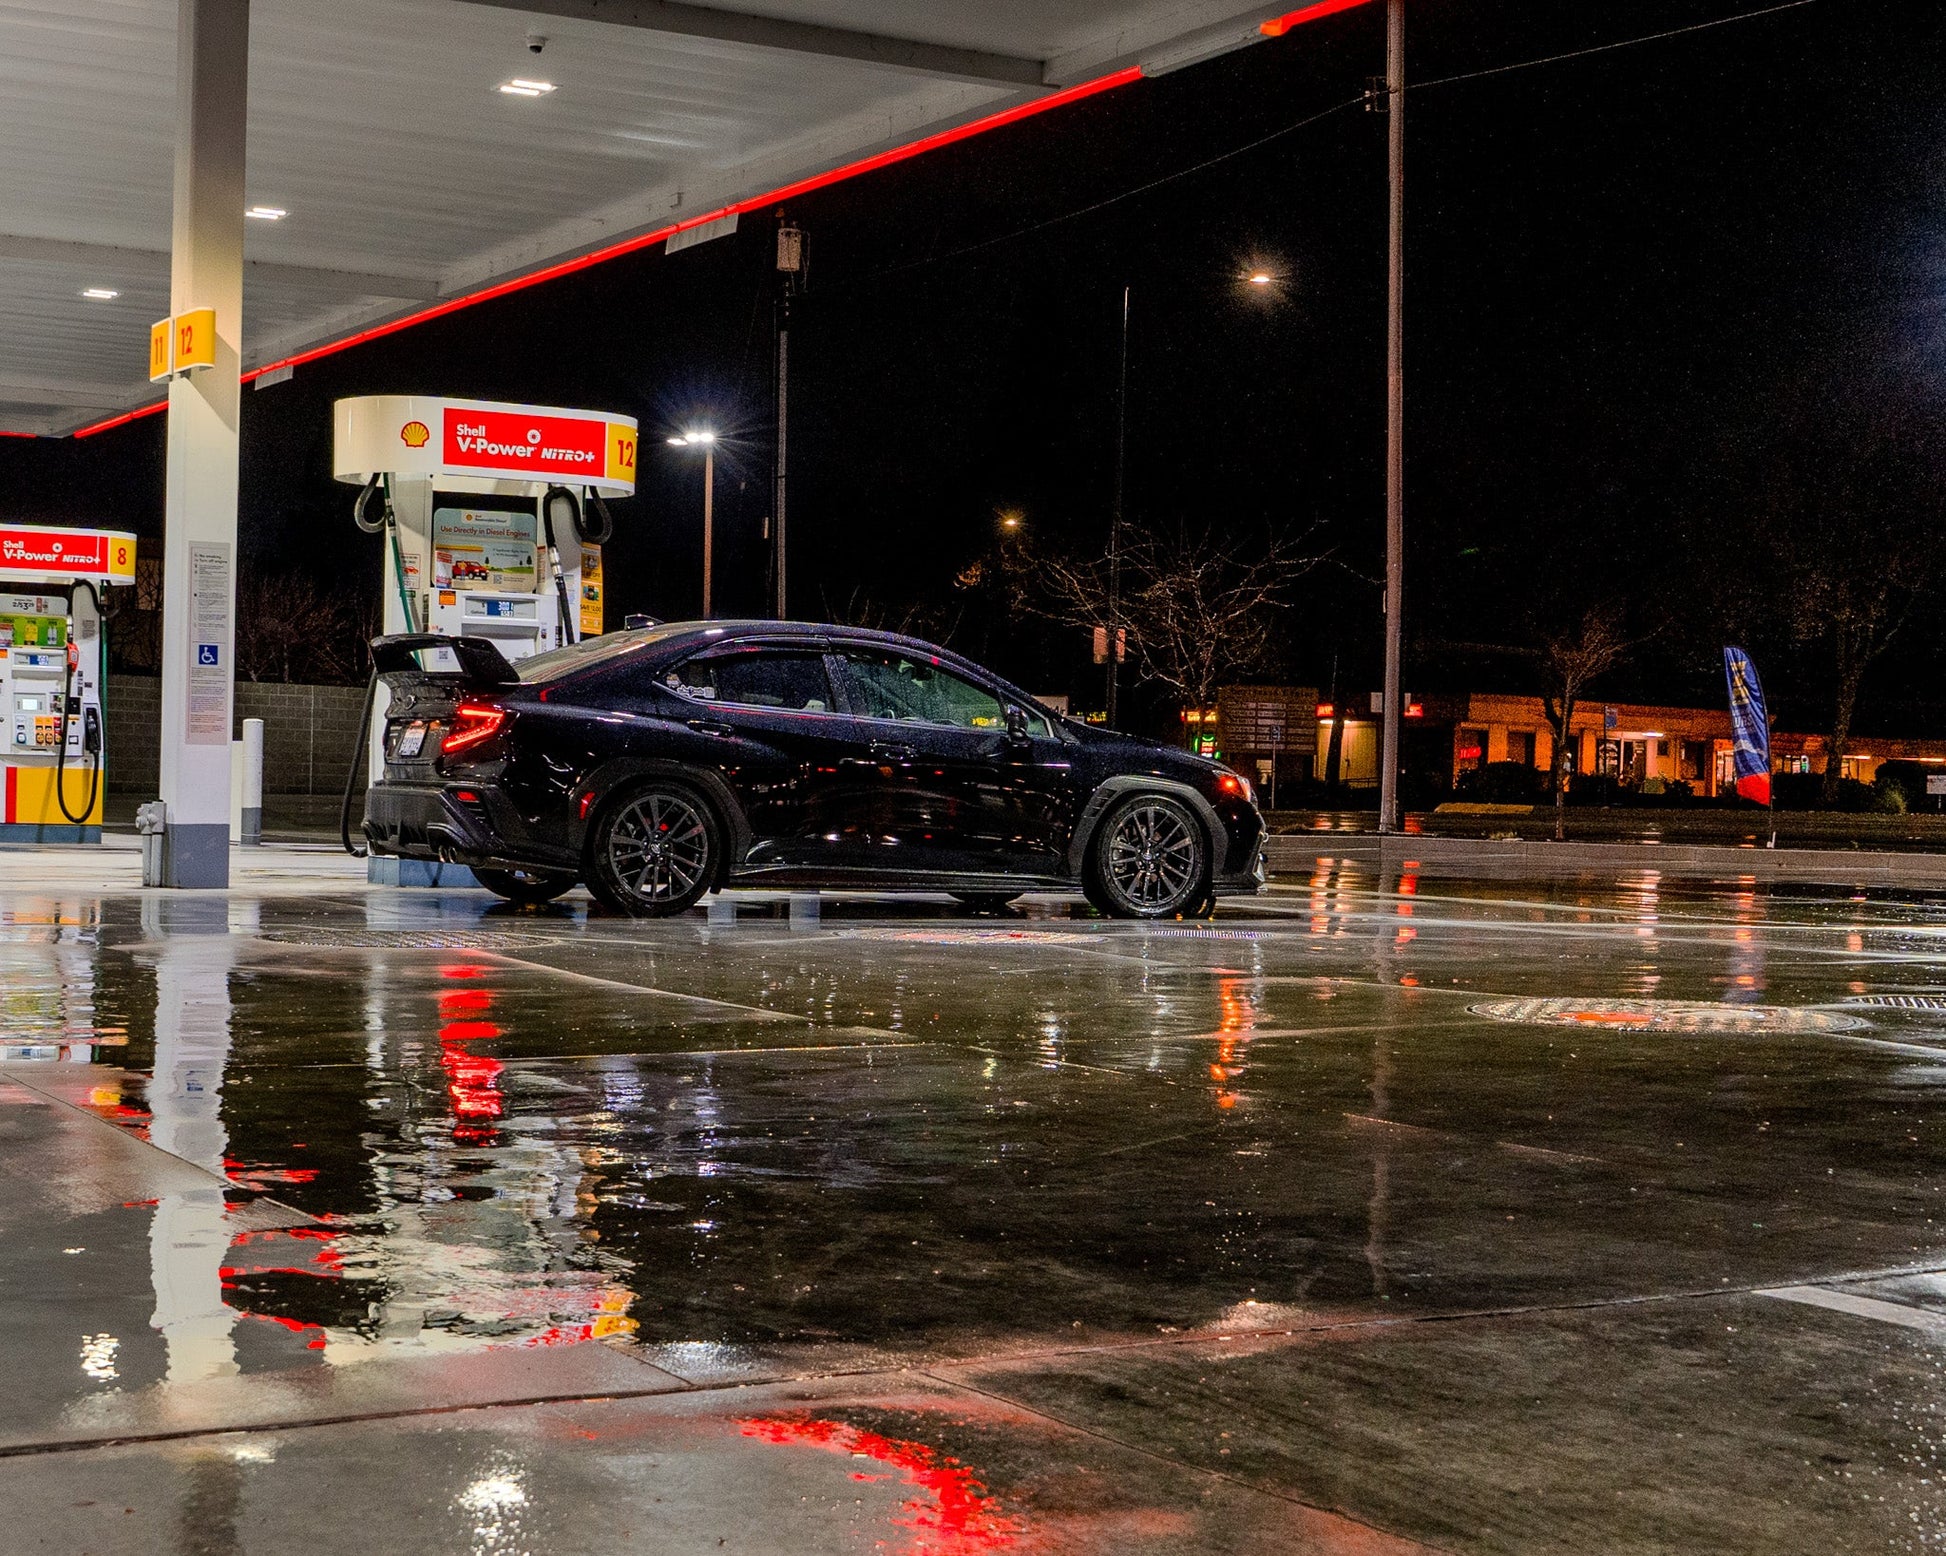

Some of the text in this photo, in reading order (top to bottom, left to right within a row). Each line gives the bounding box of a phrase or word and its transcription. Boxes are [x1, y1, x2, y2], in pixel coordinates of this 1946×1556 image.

[181, 325, 193, 356] 12
[155, 336, 163, 366] 11
[456, 424, 486, 437] Shell
[456, 436, 535, 458] V-Power
[617, 439, 634, 468] 12
[454, 526, 478, 536] Directly
[486, 528, 505, 536] Diesel
[506, 530, 530, 538] Engines
[3, 540, 24, 549] Shell
[3, 548, 58, 562] V-Power
[117, 547, 127, 565] 8
